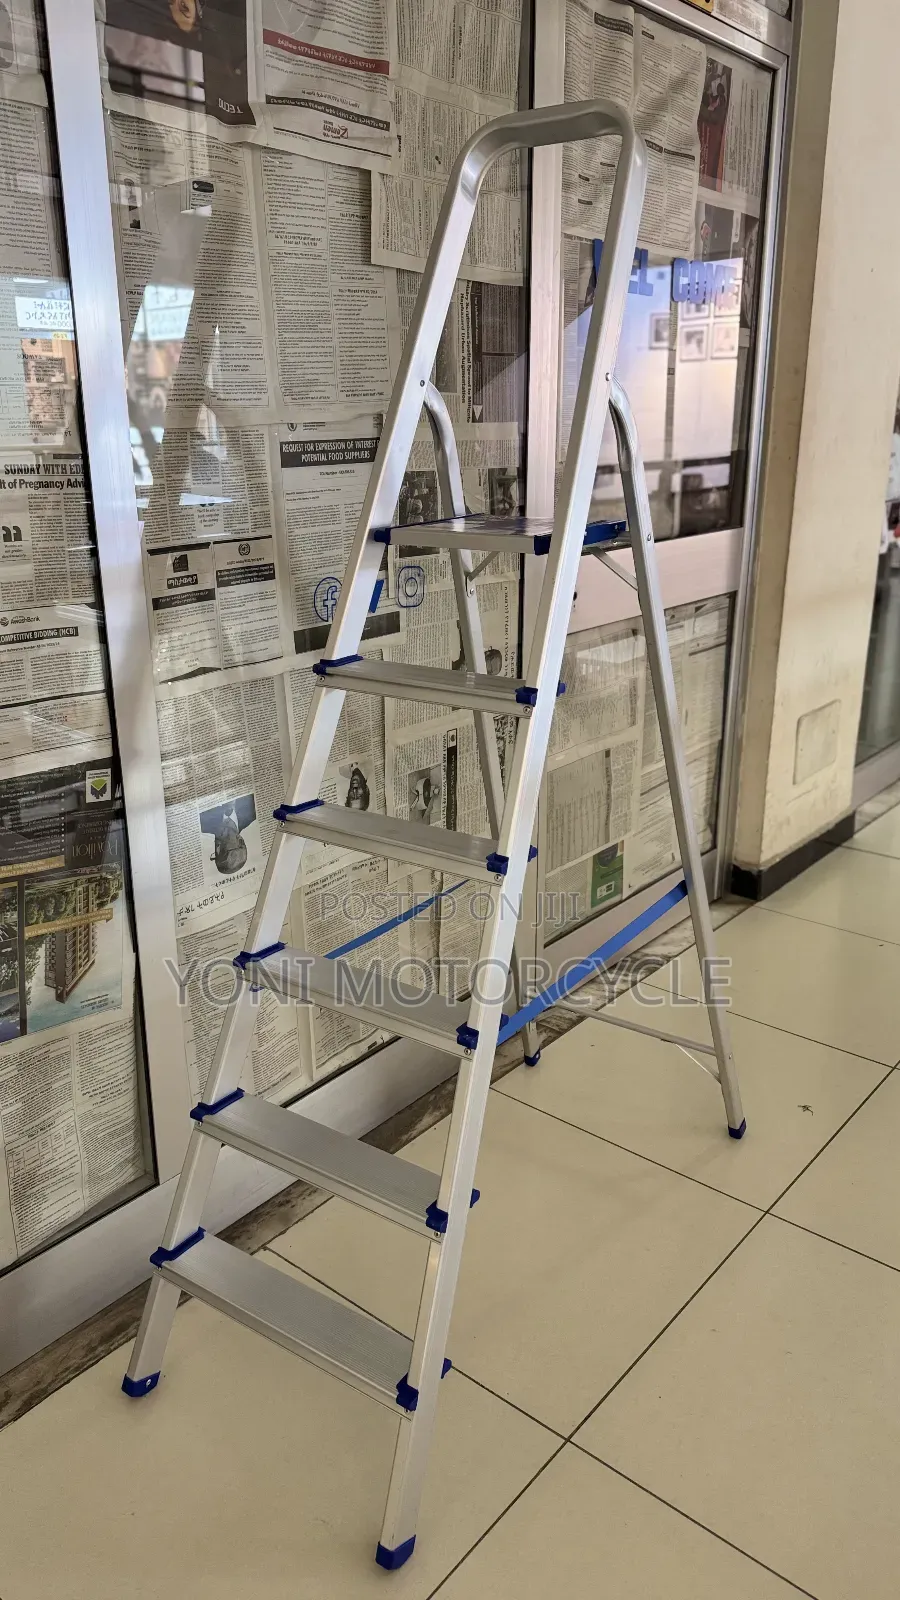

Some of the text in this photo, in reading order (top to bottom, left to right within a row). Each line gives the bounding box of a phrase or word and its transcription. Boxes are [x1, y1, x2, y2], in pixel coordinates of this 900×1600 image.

[218, 97, 244, 114] TECNO
[322, 124, 349, 139] Zemen
[592, 238, 738, 306] EL COME
[282, 443, 304, 453] REQUEST
[304, 443, 315, 452] FOR
[315, 441, 346, 451] EXPRESSION
[346, 441, 355, 450] OF
[355, 439, 376, 449] INTEREST
[301, 450, 371, 463] POTENTIAL FOOD SUPPLIERS
[4, 463, 41, 475] SUNDAY
[43, 463, 68, 475] WITH
[7, 478, 18, 489] of
[18, 479, 65, 491] Pregnancy
[0, 627, 76, 643] OMPETITIVE BIDDING (NCB)
[72, 839, 118, 860] Pavilion
